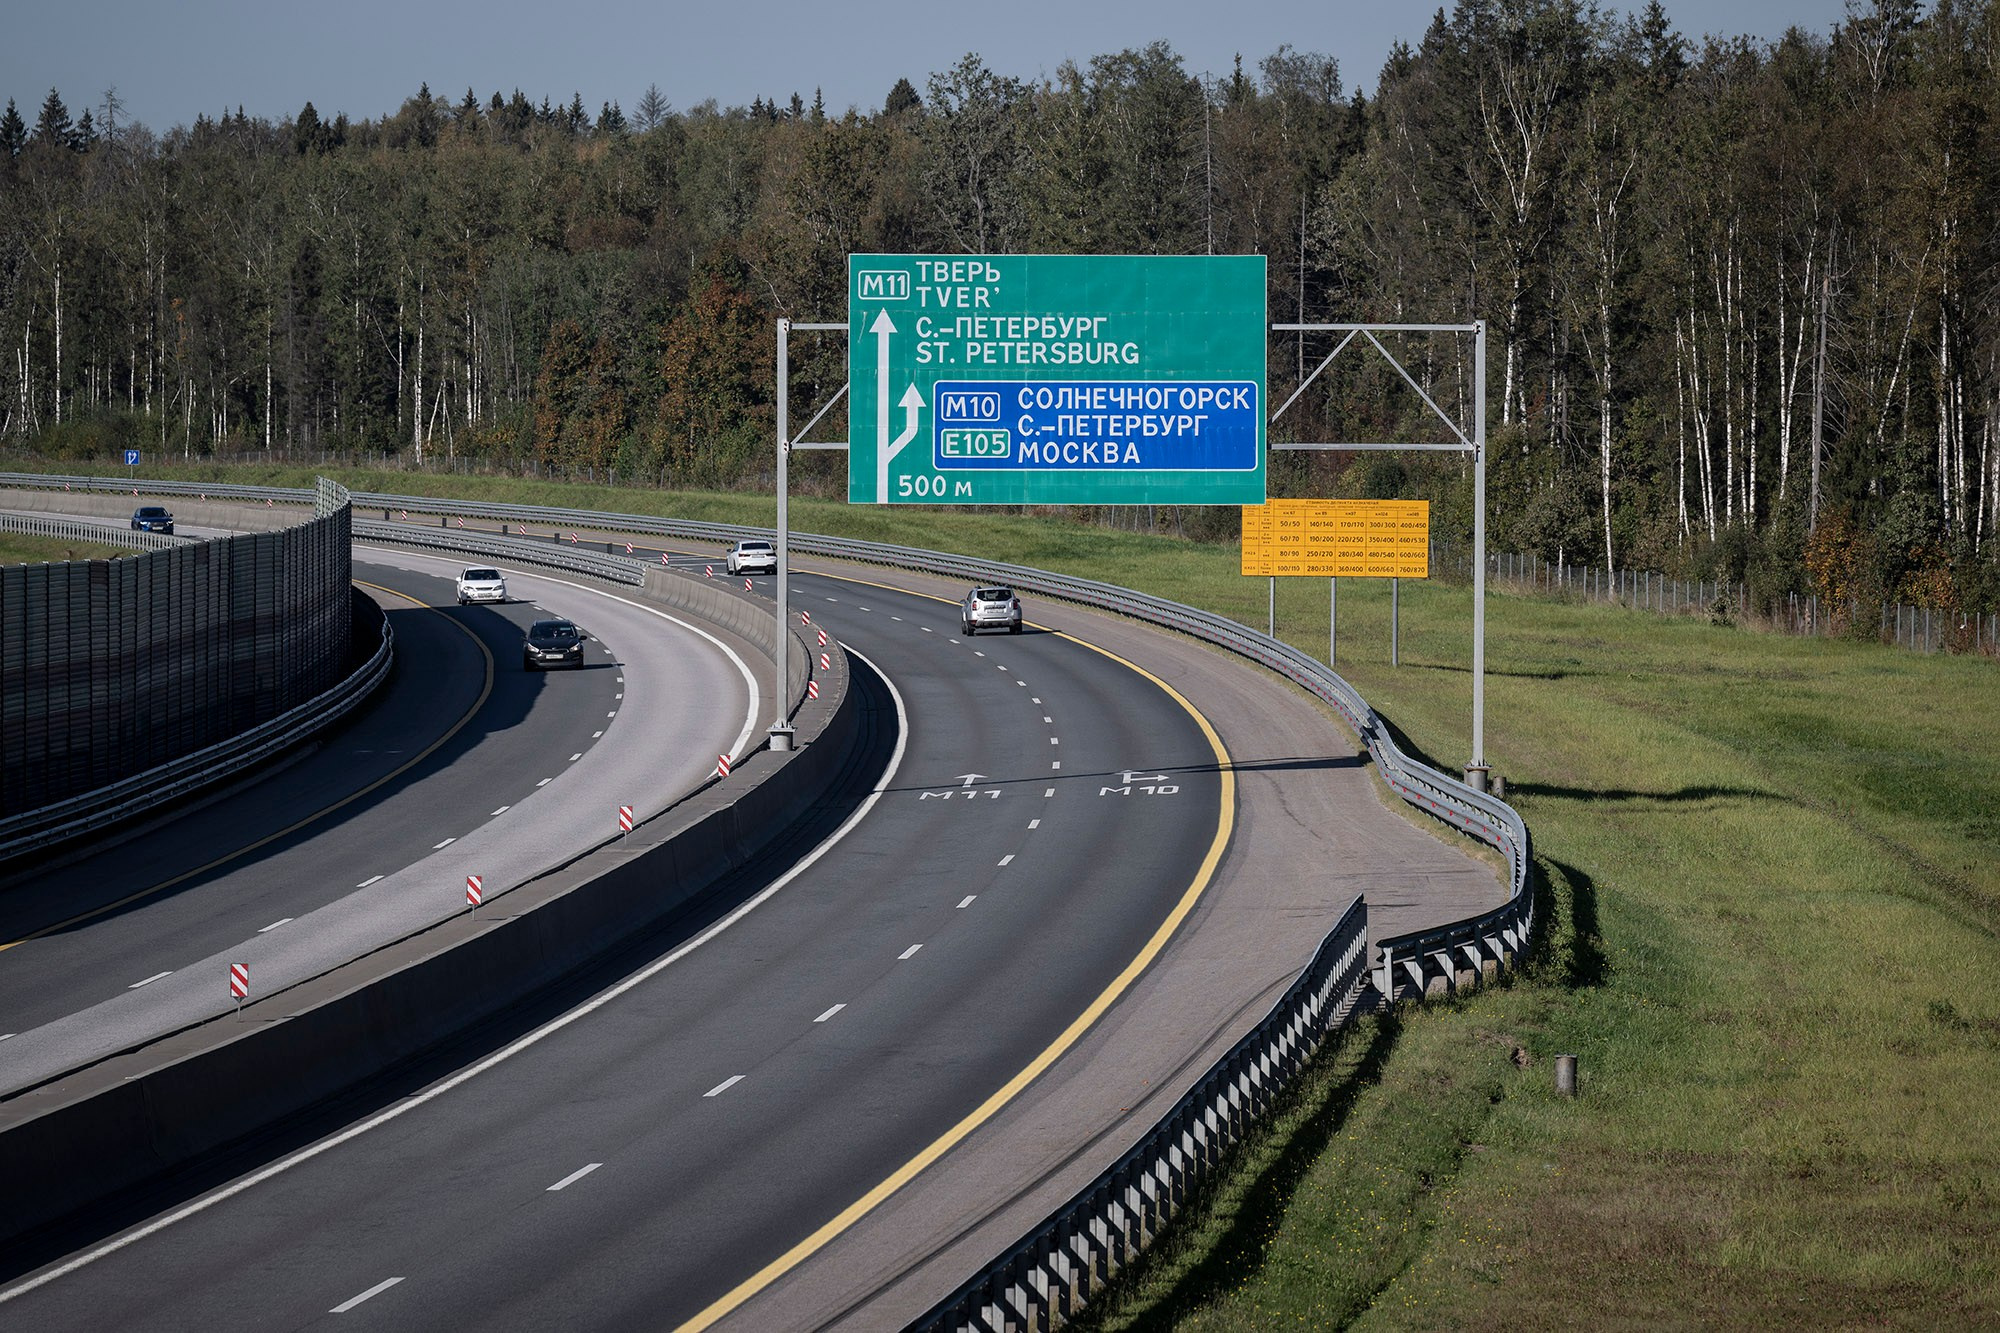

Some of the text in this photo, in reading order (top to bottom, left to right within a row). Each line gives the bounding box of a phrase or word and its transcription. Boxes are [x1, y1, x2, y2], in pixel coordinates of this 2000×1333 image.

[915, 261, 1001, 283] ТВЕРЬ
[863, 273, 909, 298] M11
[915, 286, 1000, 308] TVER'
[915, 316, 1108, 339] С.-ПЕТЕРБУРГ
[915, 342, 1140, 365] ST. PETERSBURG
[945, 395, 996, 418] M10
[1017, 387, 1251, 410] СОЛНЕЧНОГОРСК
[1017, 415, 1209, 437] С.-ПЕТЕРБУРГ
[945, 433, 1006, 455] E105
[1017, 442, 1141, 464] МОСКВА
[898, 475, 973, 497] 500 м
[919, 790, 1002, 800] M11
[1099, 785, 1180, 796] M10
